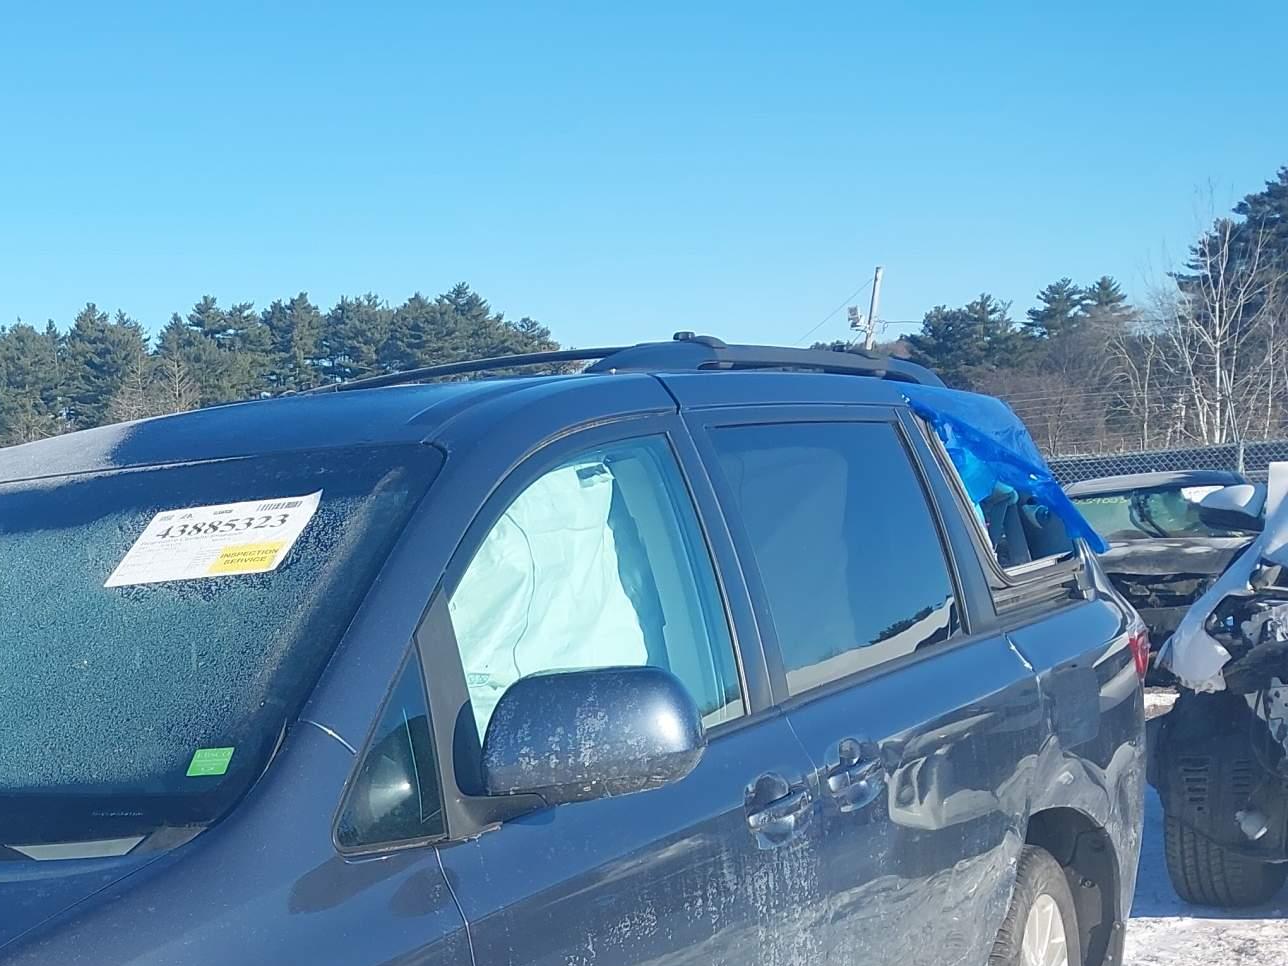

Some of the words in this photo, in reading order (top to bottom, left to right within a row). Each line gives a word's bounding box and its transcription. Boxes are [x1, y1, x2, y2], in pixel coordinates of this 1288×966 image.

[156, 514, 290, 539] 43885323
[220, 548, 279, 559] INSPECTION
[223, 556, 267, 565] SERVICE
